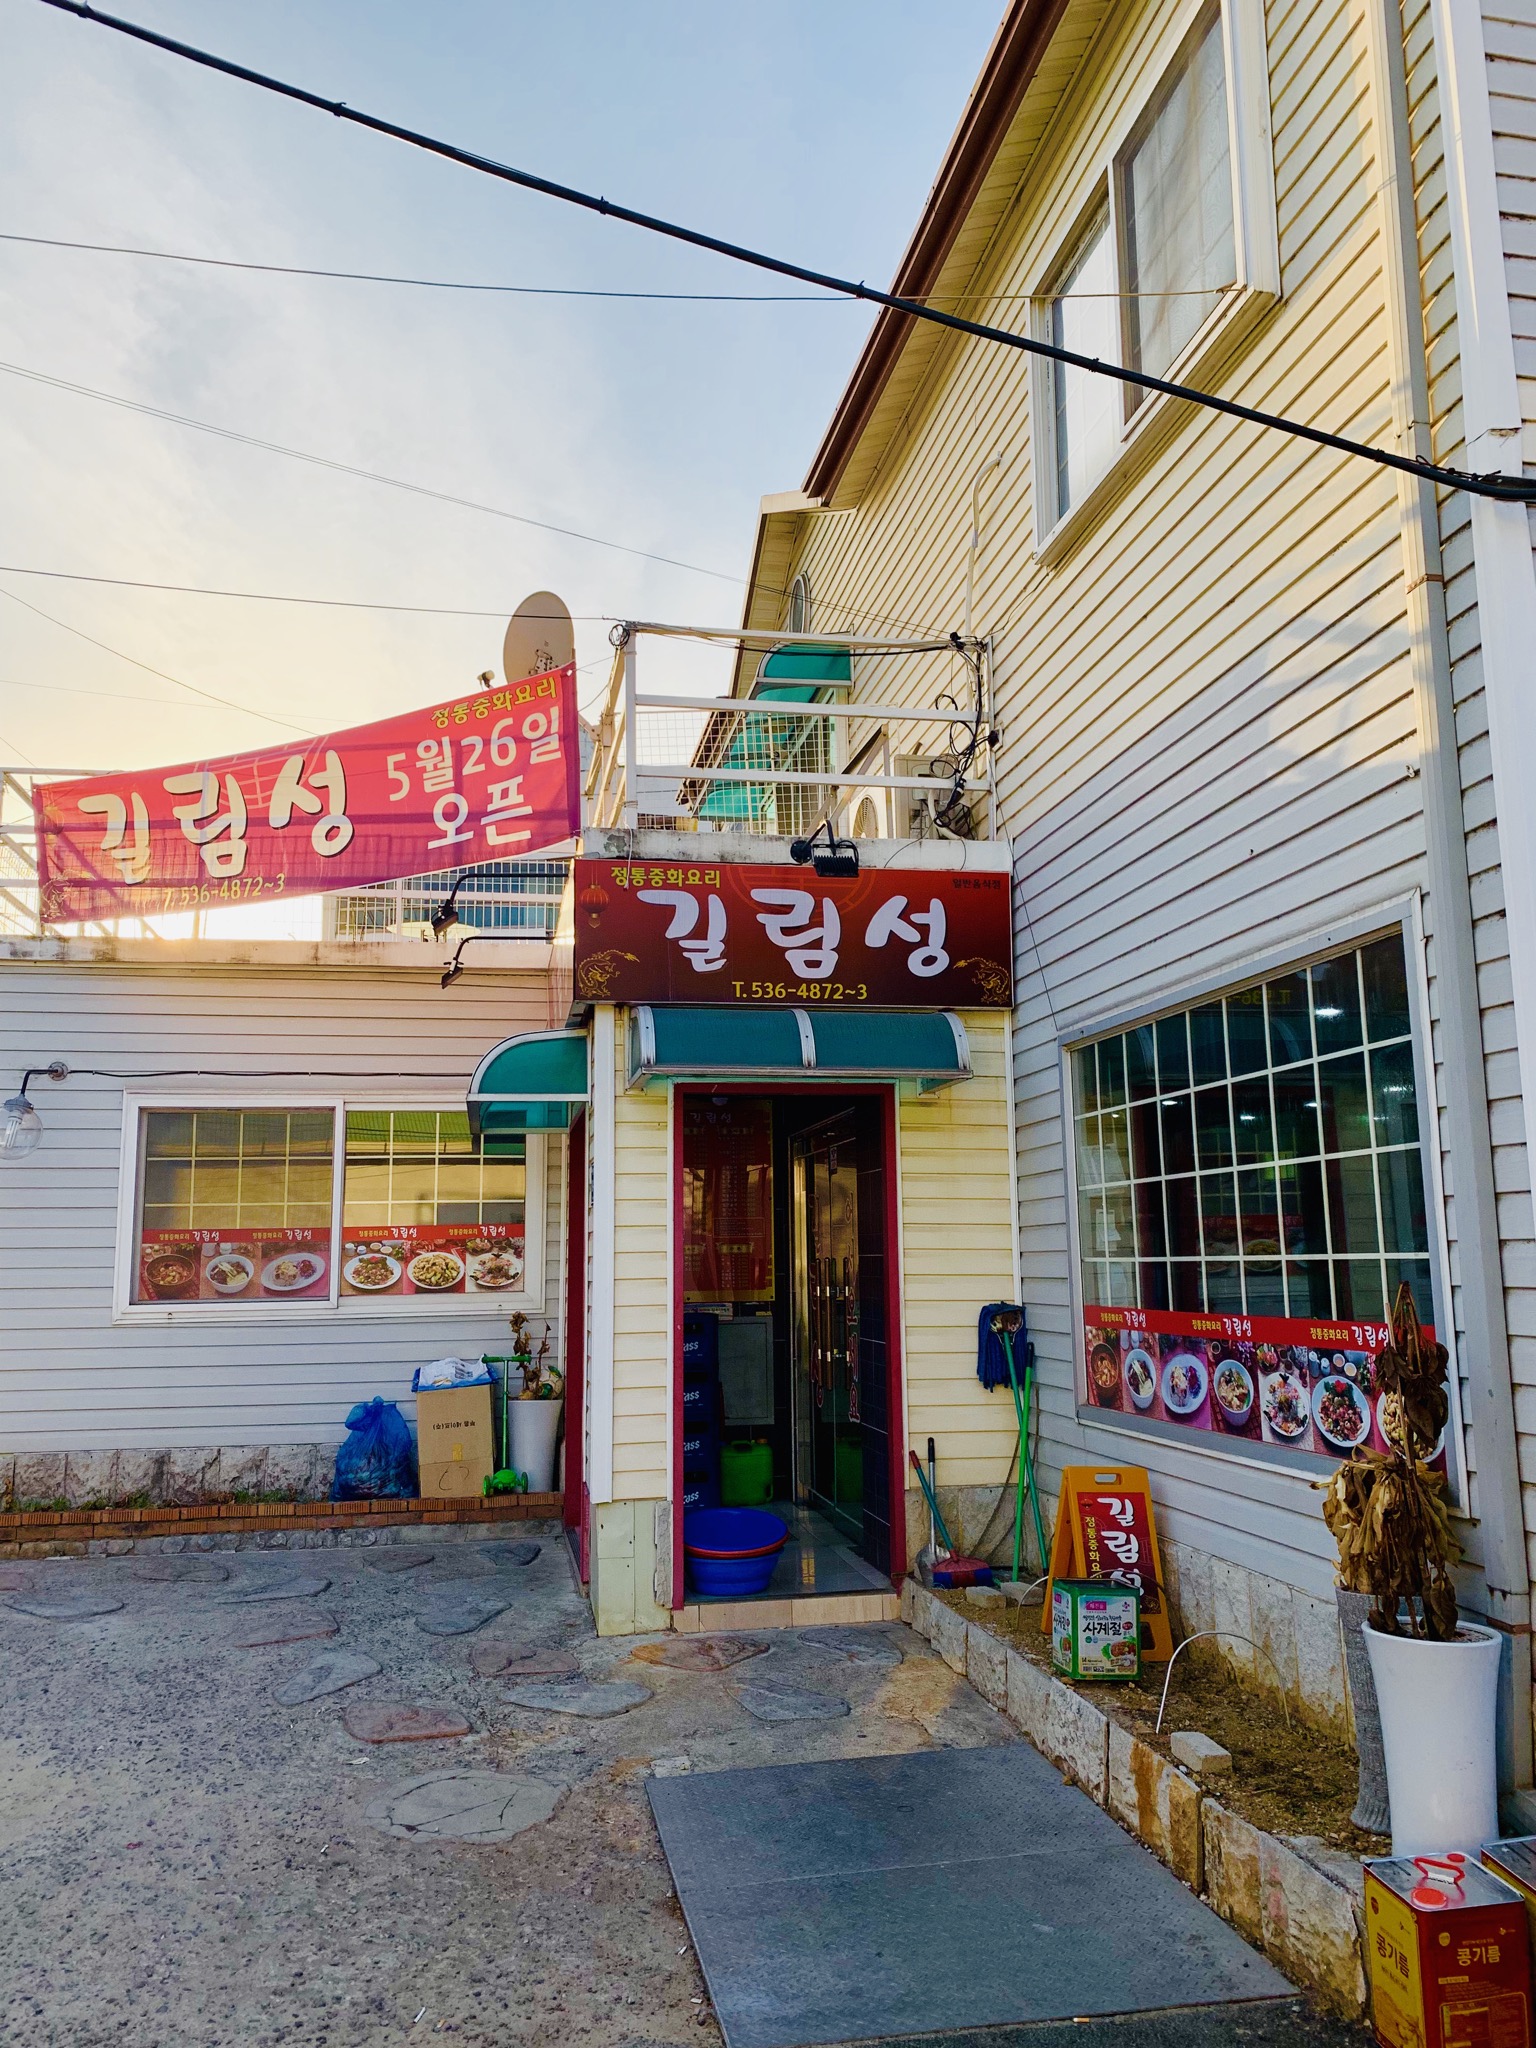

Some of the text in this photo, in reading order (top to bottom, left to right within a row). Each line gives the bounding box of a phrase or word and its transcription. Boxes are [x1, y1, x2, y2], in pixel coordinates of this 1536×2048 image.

[77, 749, 355, 886] 길림성
[427, 774, 535, 851] 오픈
[611, 866, 720, 889] 정통중화요리
[636, 887, 951, 979] 길림성
[192, 1230, 220, 1242] 길림성
[285, 1229, 312, 1241] 길림성
[391, 1227, 417, 1238] 길림성
[480, 1225, 506, 1236] 길림성
[1124, 1311, 1147, 1328] 길림성
[1191, 1318, 1252, 1337] 정통중화요리 길림성
[1309, 1327, 1349, 1341] 정통중화요리
[1085, 1516, 1102, 1578] 정통중화요
[1082, 1621, 1122, 1636] 사계절
[1376, 1932, 1409, 1979] 콩기름
[1456, 1945, 1501, 1967] 콩기름
